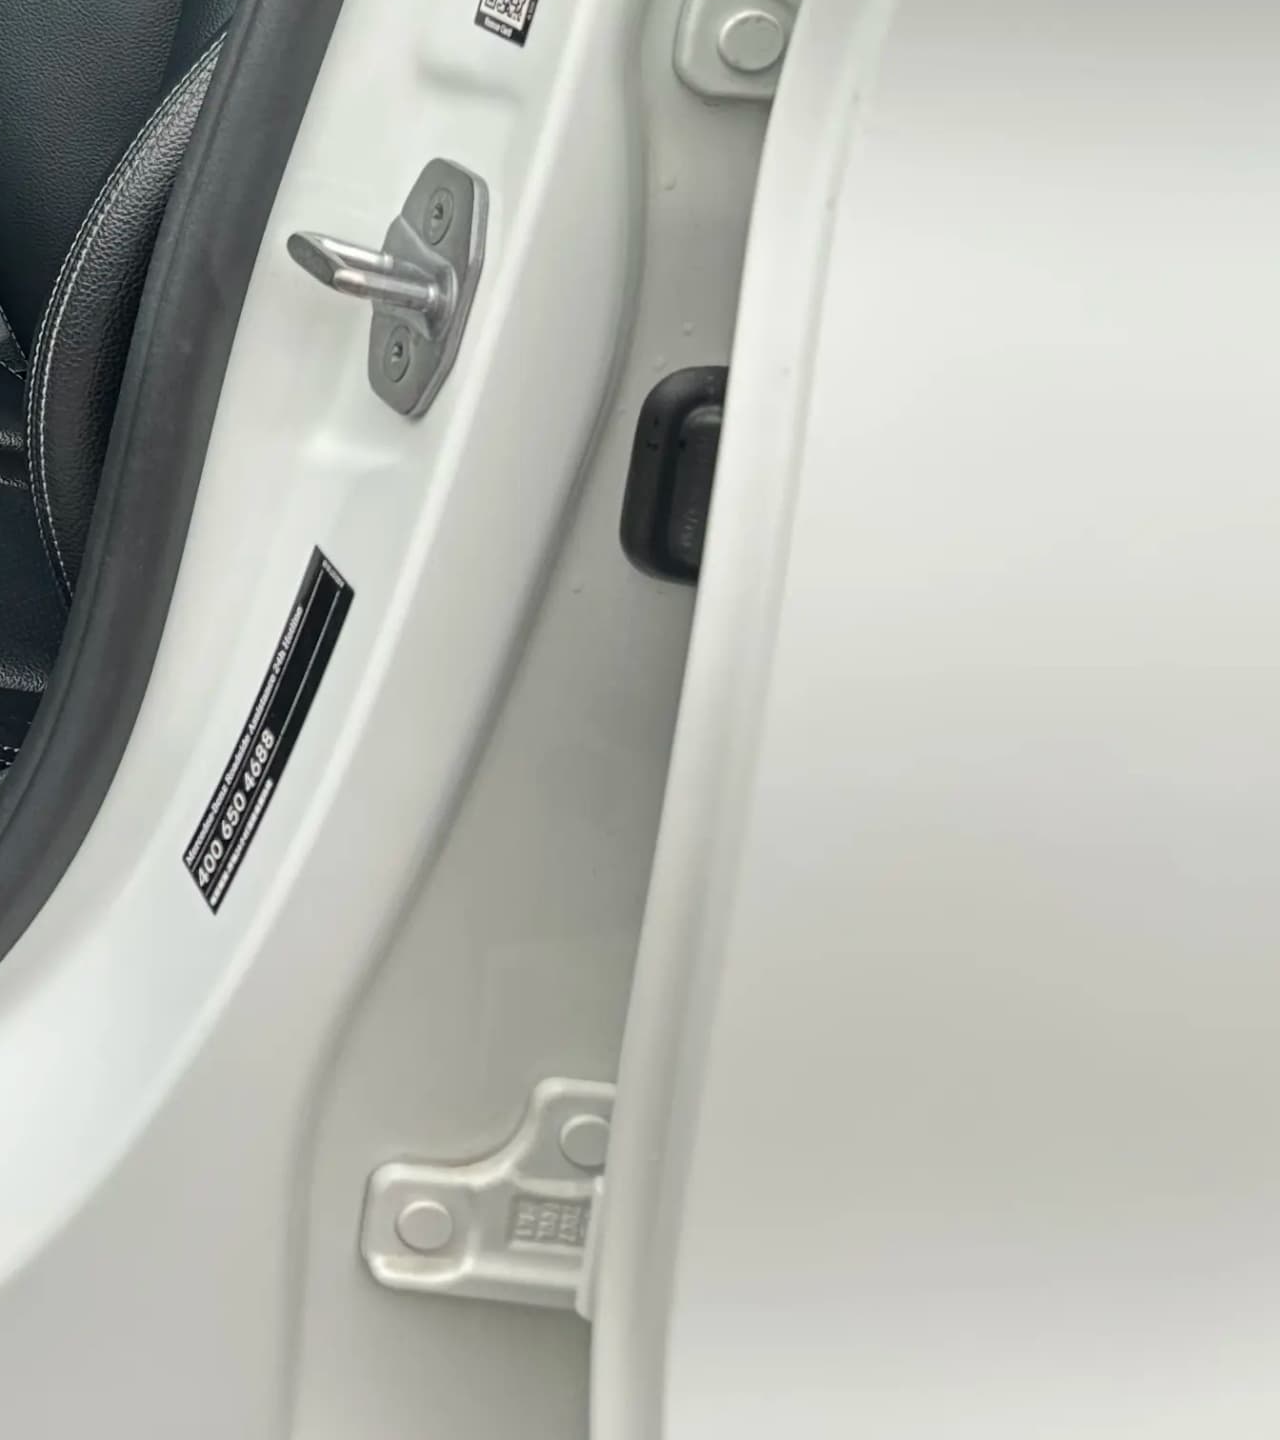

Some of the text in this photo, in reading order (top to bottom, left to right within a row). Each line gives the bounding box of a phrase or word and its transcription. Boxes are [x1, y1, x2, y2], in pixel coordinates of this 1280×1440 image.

[198, 839, 223, 887] 400
[221, 790, 247, 840] 650
[244, 727, 275, 792] 4688
